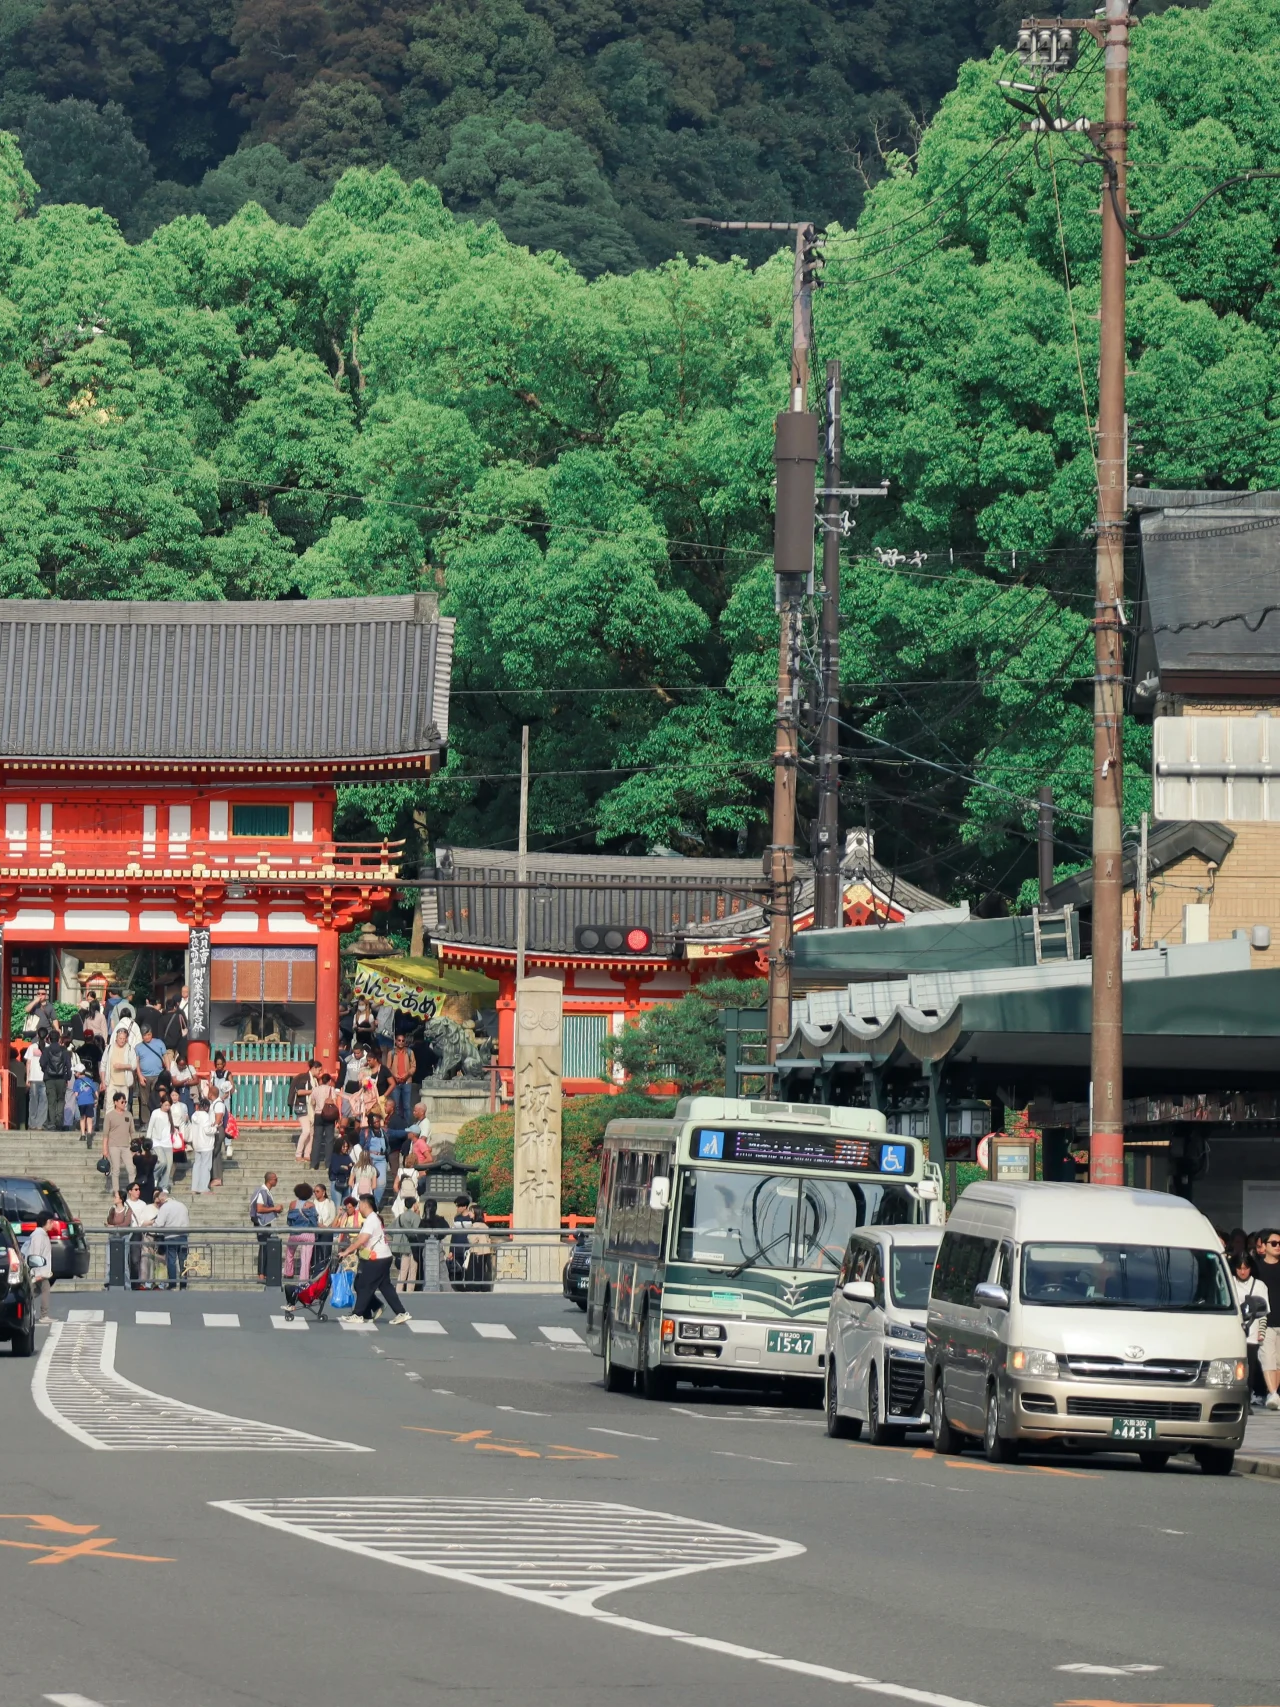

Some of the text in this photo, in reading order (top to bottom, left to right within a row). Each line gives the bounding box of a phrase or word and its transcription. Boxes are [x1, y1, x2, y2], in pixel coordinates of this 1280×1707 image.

[355, 972, 437, 1018] りんごあめ
[518, 1057, 559, 1200] 八坂神社
[777, 1337, 812, 1353] 15-47
[1121, 1426, 1152, 1439] 44-51
